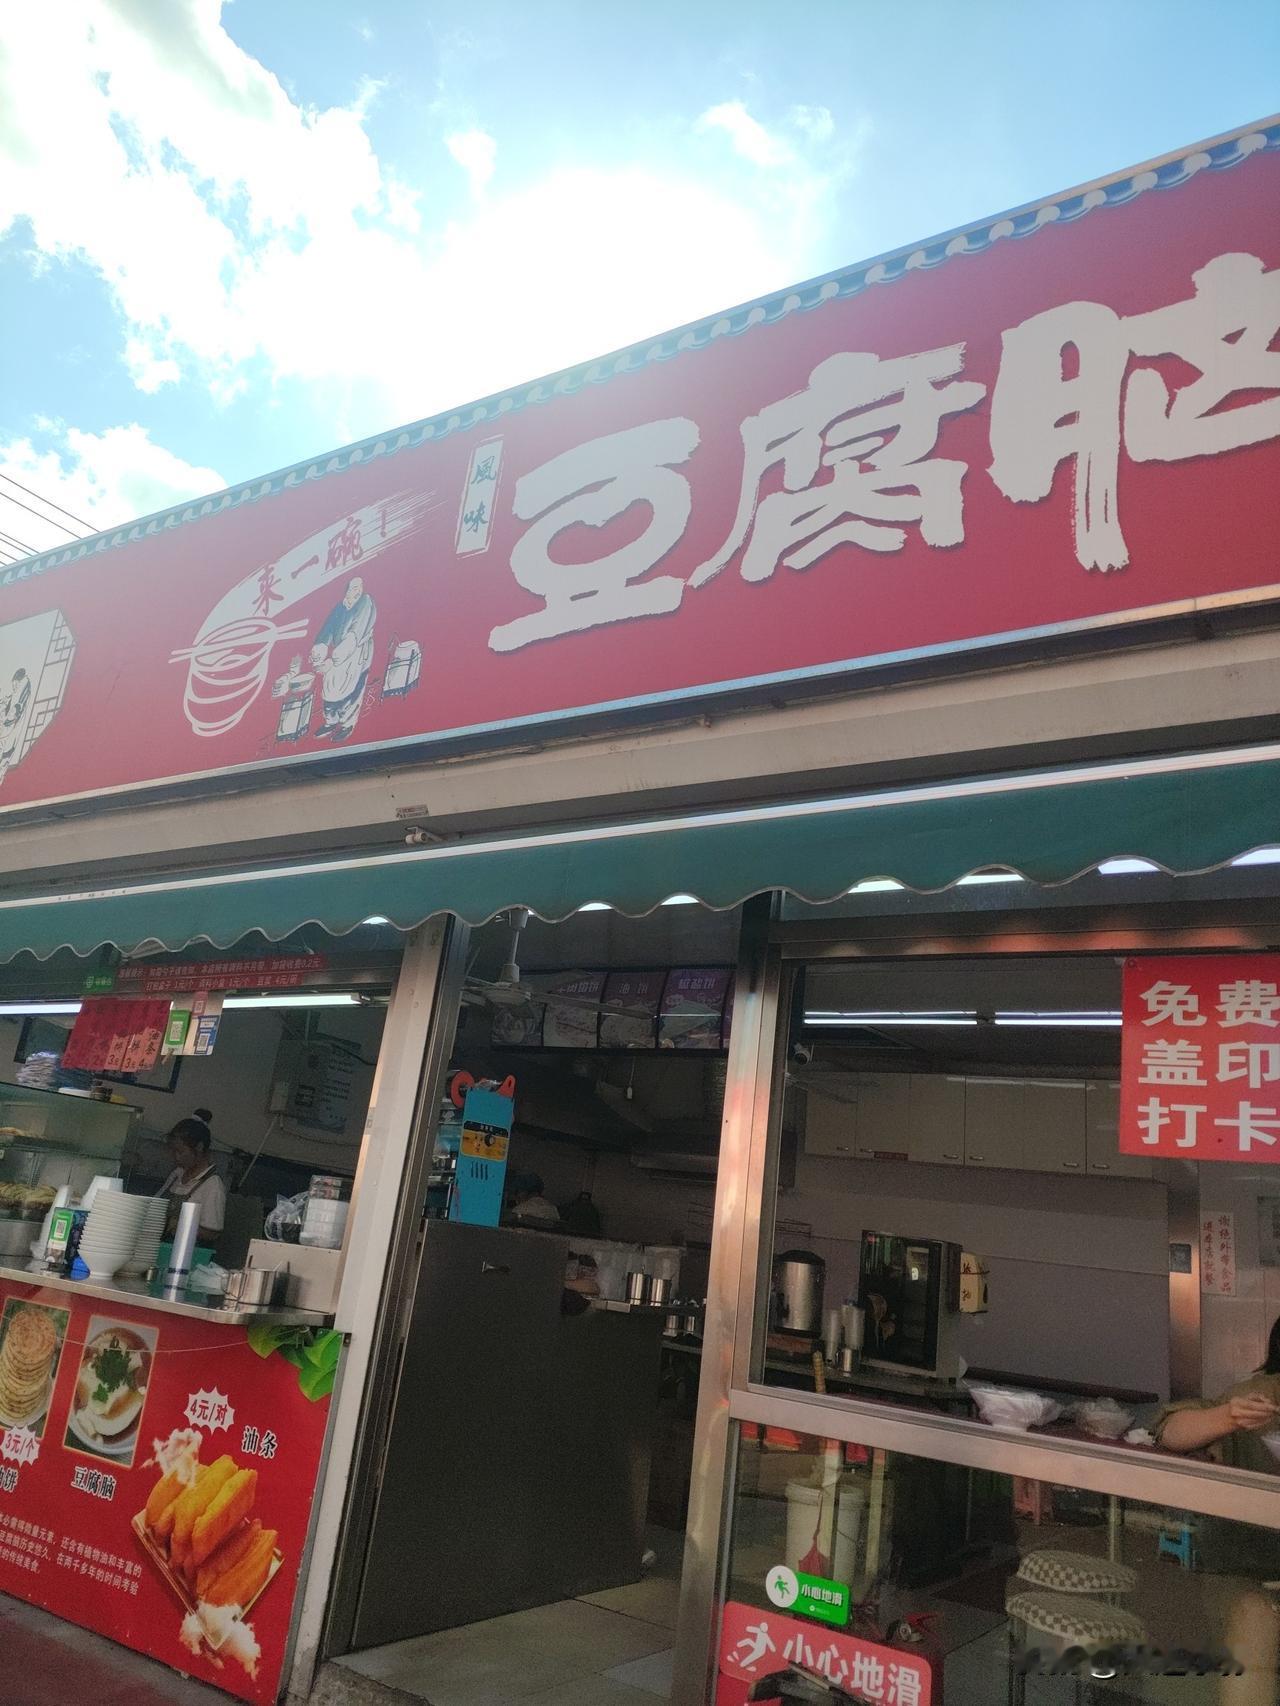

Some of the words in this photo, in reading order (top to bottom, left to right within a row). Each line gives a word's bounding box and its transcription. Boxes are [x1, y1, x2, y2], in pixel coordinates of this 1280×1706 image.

[1139, 980, 1280, 1028] 免费
[1138, 1039, 1280, 1089] 盖印
[1137, 1097, 1280, 1151] 打卡
[190, 1399, 227, 1425] 4元/对
[5, 1433, 34, 1458] 3元/个
[241, 1426, 277, 1459] 油条
[70, 1466, 117, 1501] 豆腐脑
[801, 1583, 842, 1607] 小心地滑
[782, 1633, 922, 1706] 小心地滑
